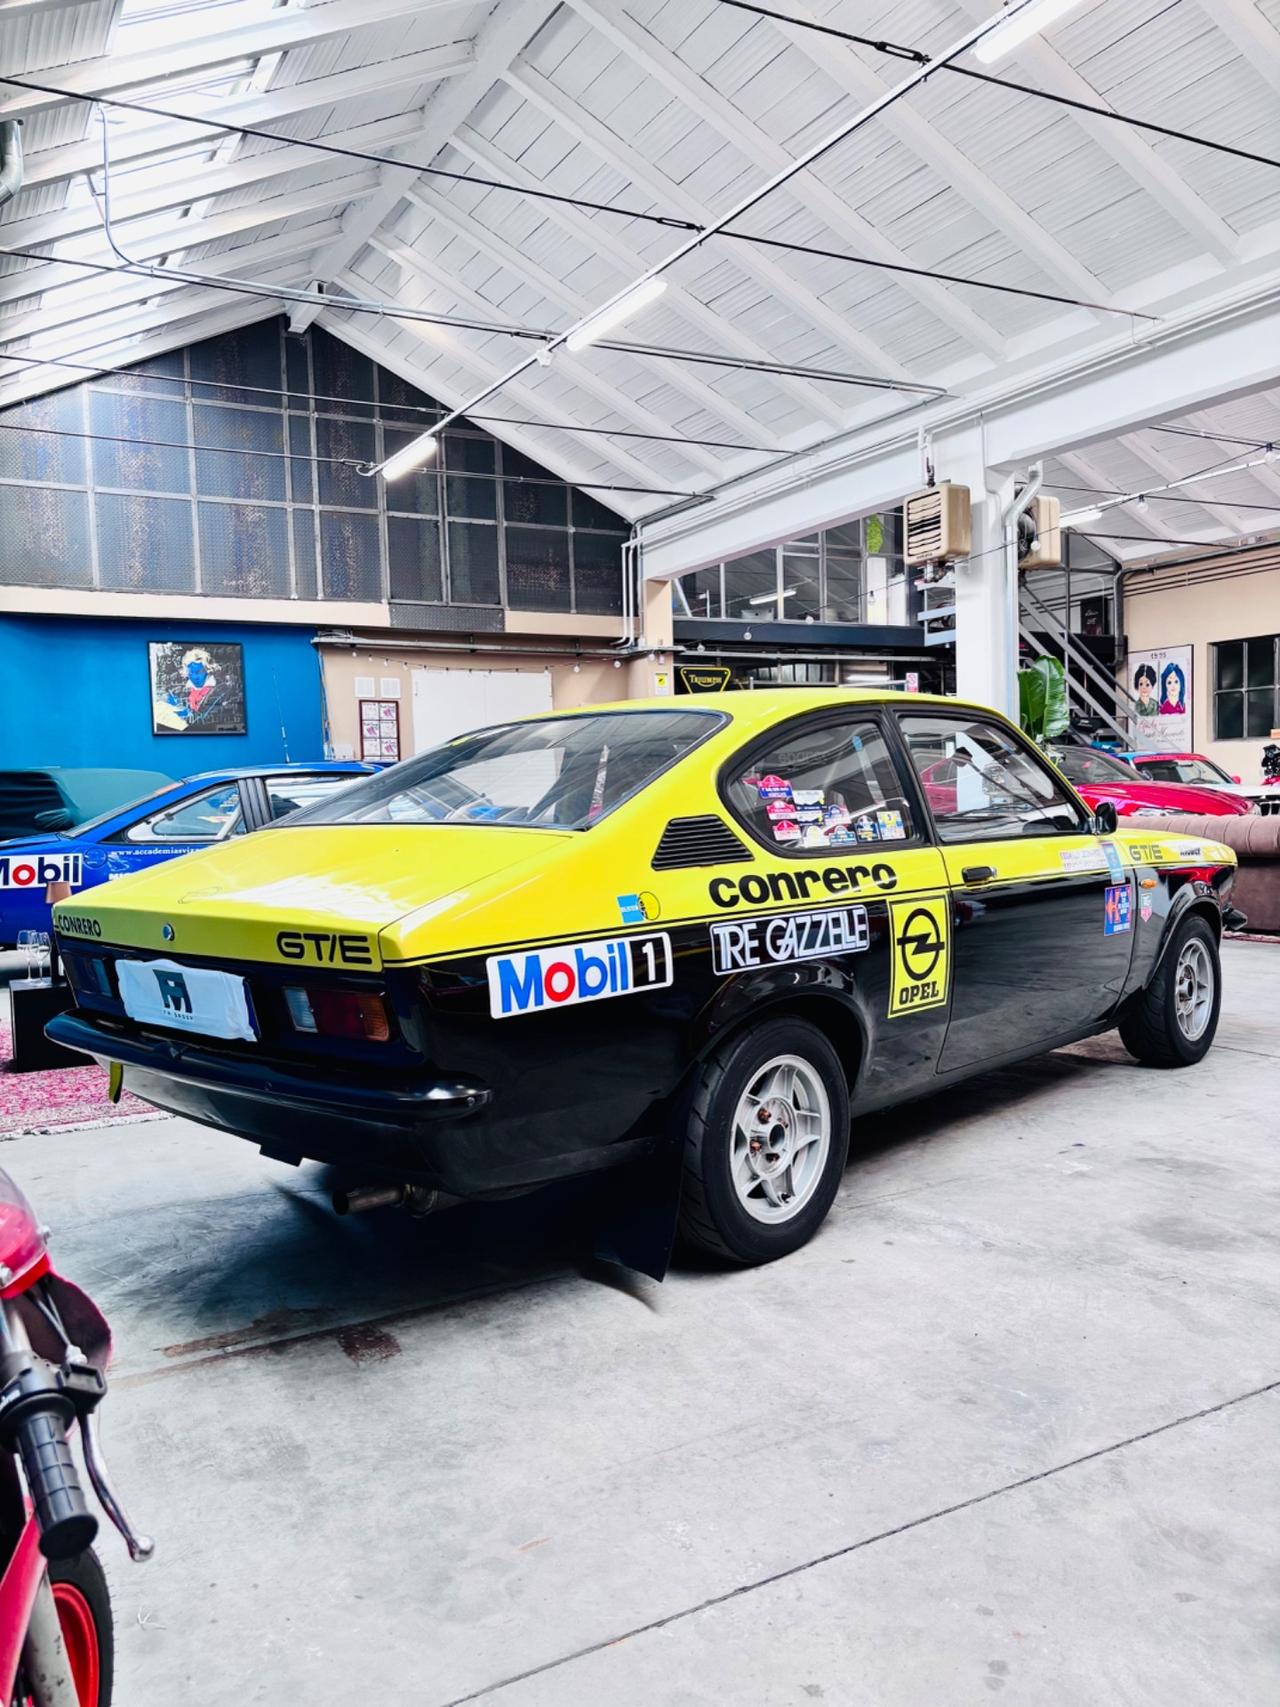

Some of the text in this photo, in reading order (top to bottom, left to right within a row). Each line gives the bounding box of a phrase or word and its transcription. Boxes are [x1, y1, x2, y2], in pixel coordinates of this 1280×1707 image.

[1128, 844, 1164, 861] GT/E
[708, 863, 898, 908] conrero
[58, 914, 102, 937] CONRERO
[276, 931, 373, 965] GT/E
[713, 922, 760, 970] TRE
[497, 942, 656, 1013] Mobil 1
[899, 981, 940, 1005] OPEL
